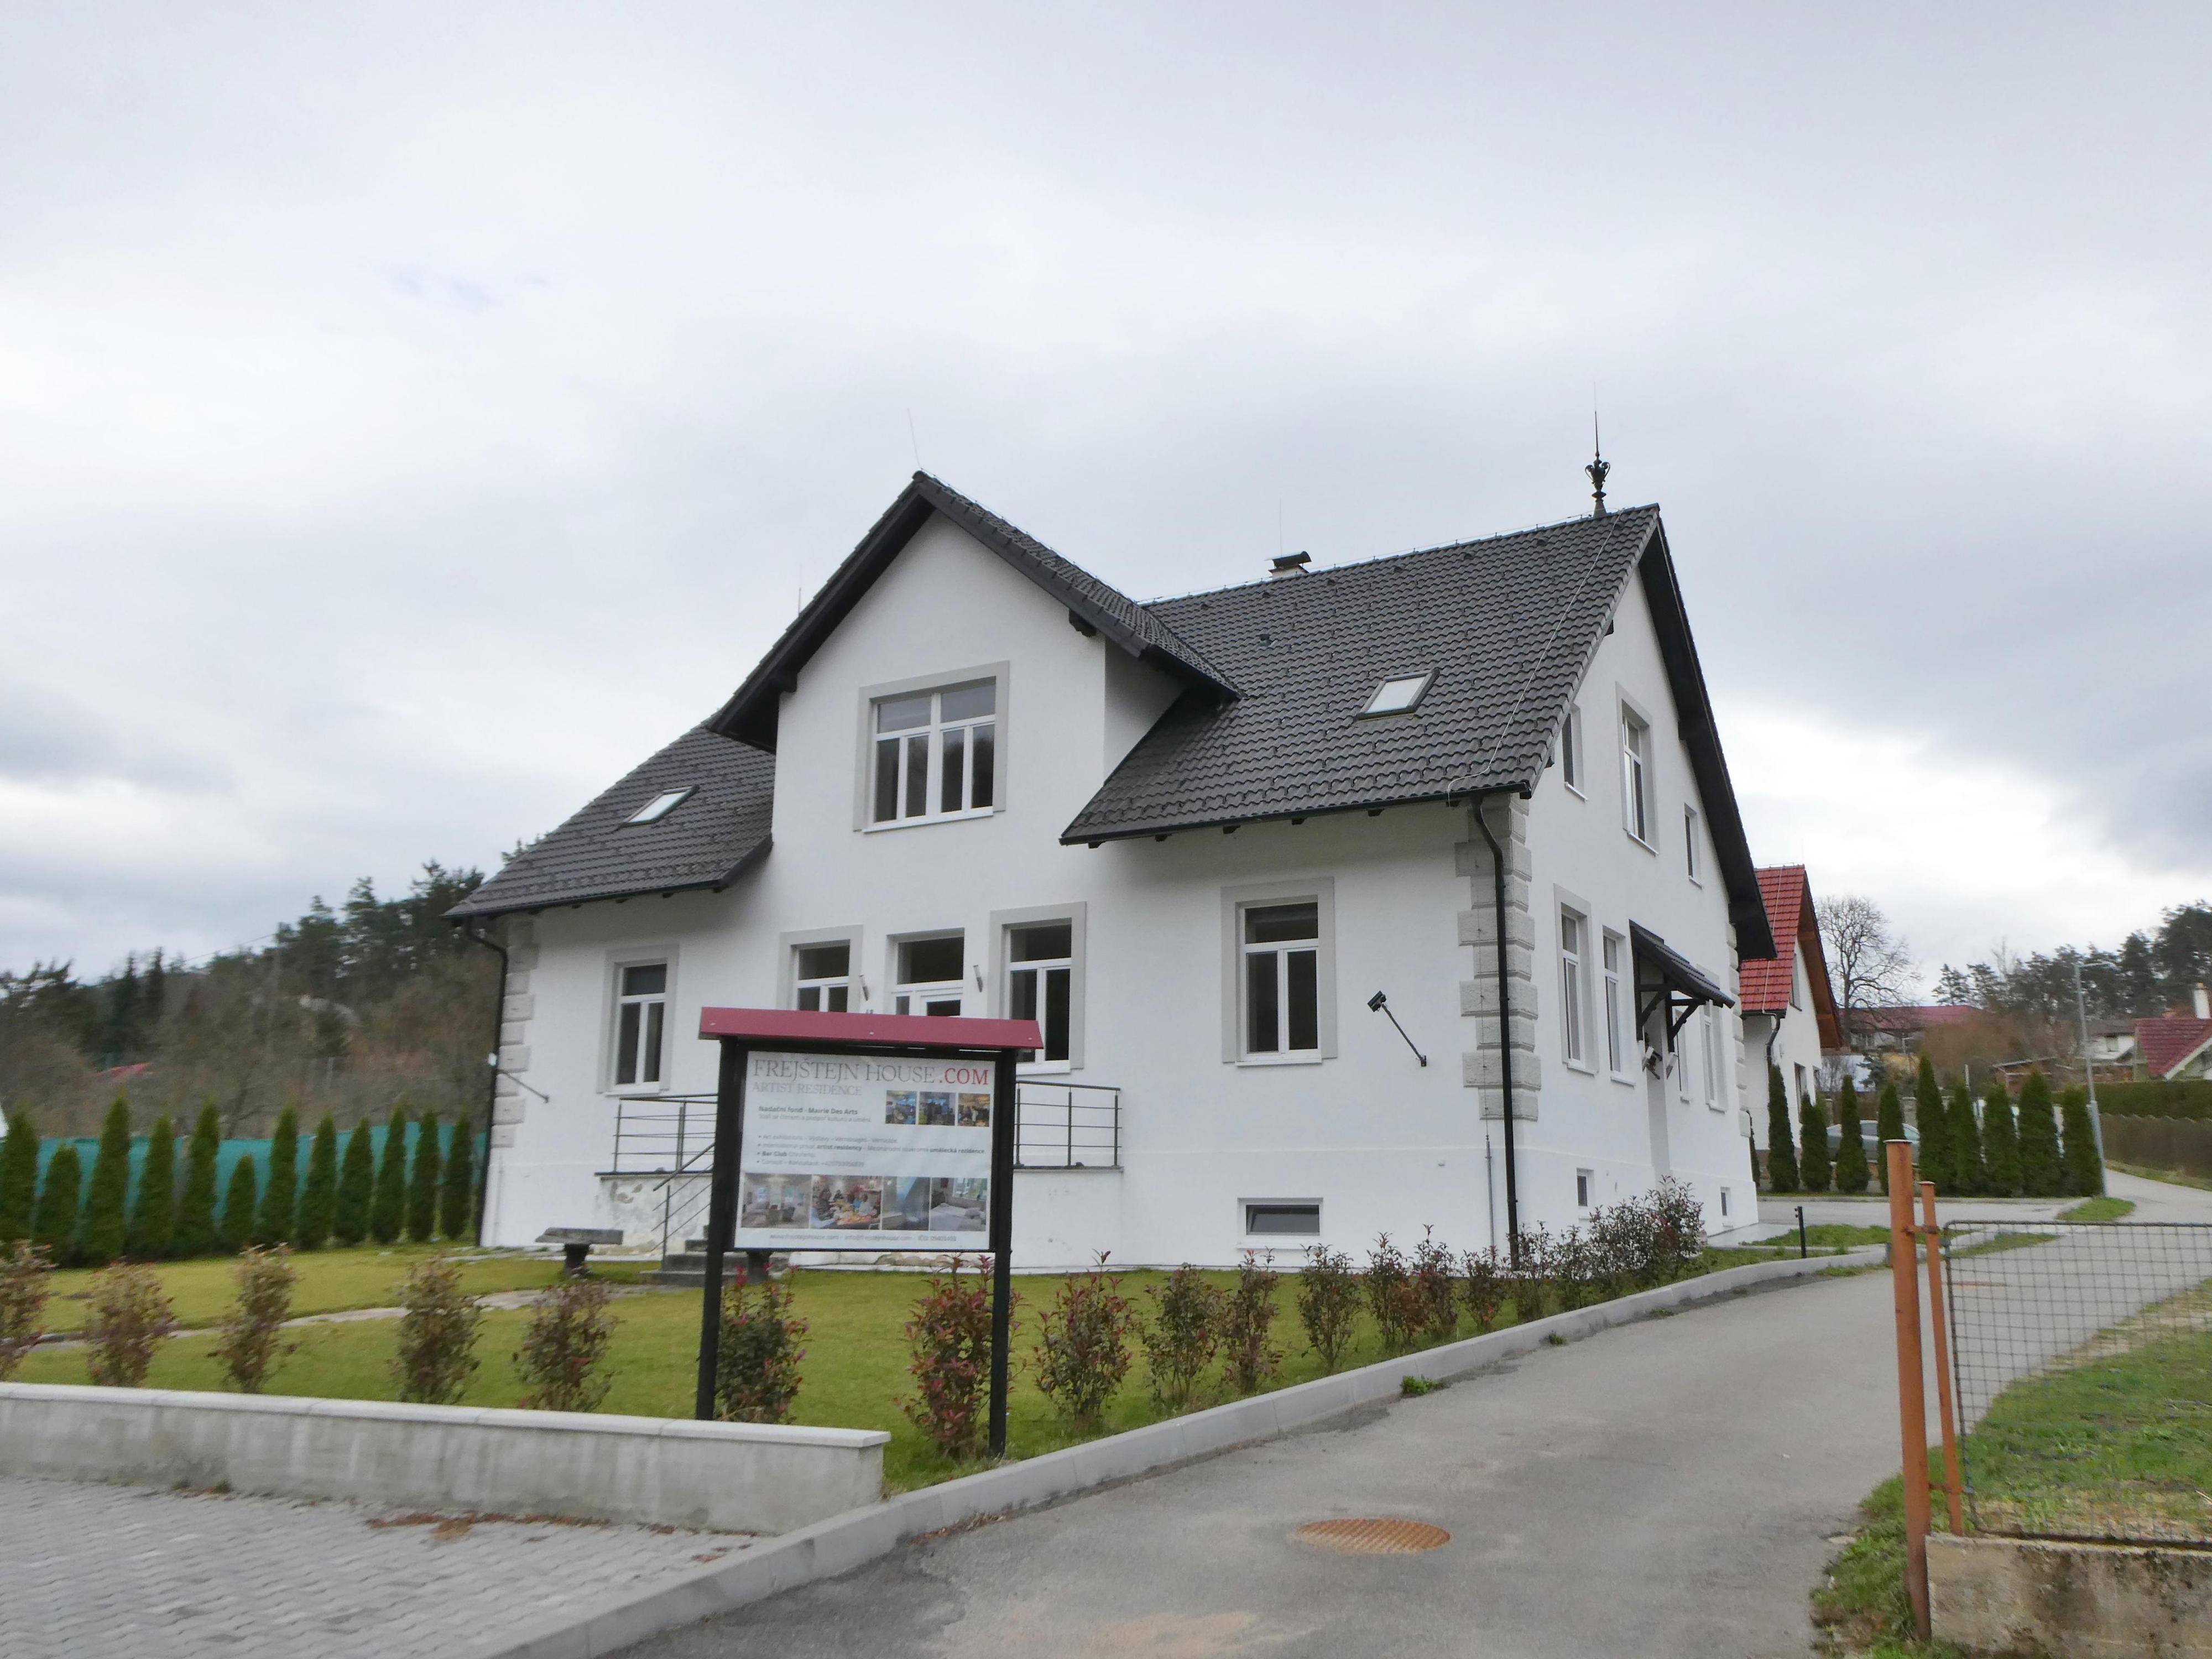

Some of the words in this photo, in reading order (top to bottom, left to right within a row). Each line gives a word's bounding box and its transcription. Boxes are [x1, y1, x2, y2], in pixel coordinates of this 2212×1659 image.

[754, 1058, 859, 1083] FREJŠTEJN
[752, 1082, 793, 1093] ARTIST
[796, 1083, 863, 1096] RESIDENCE
